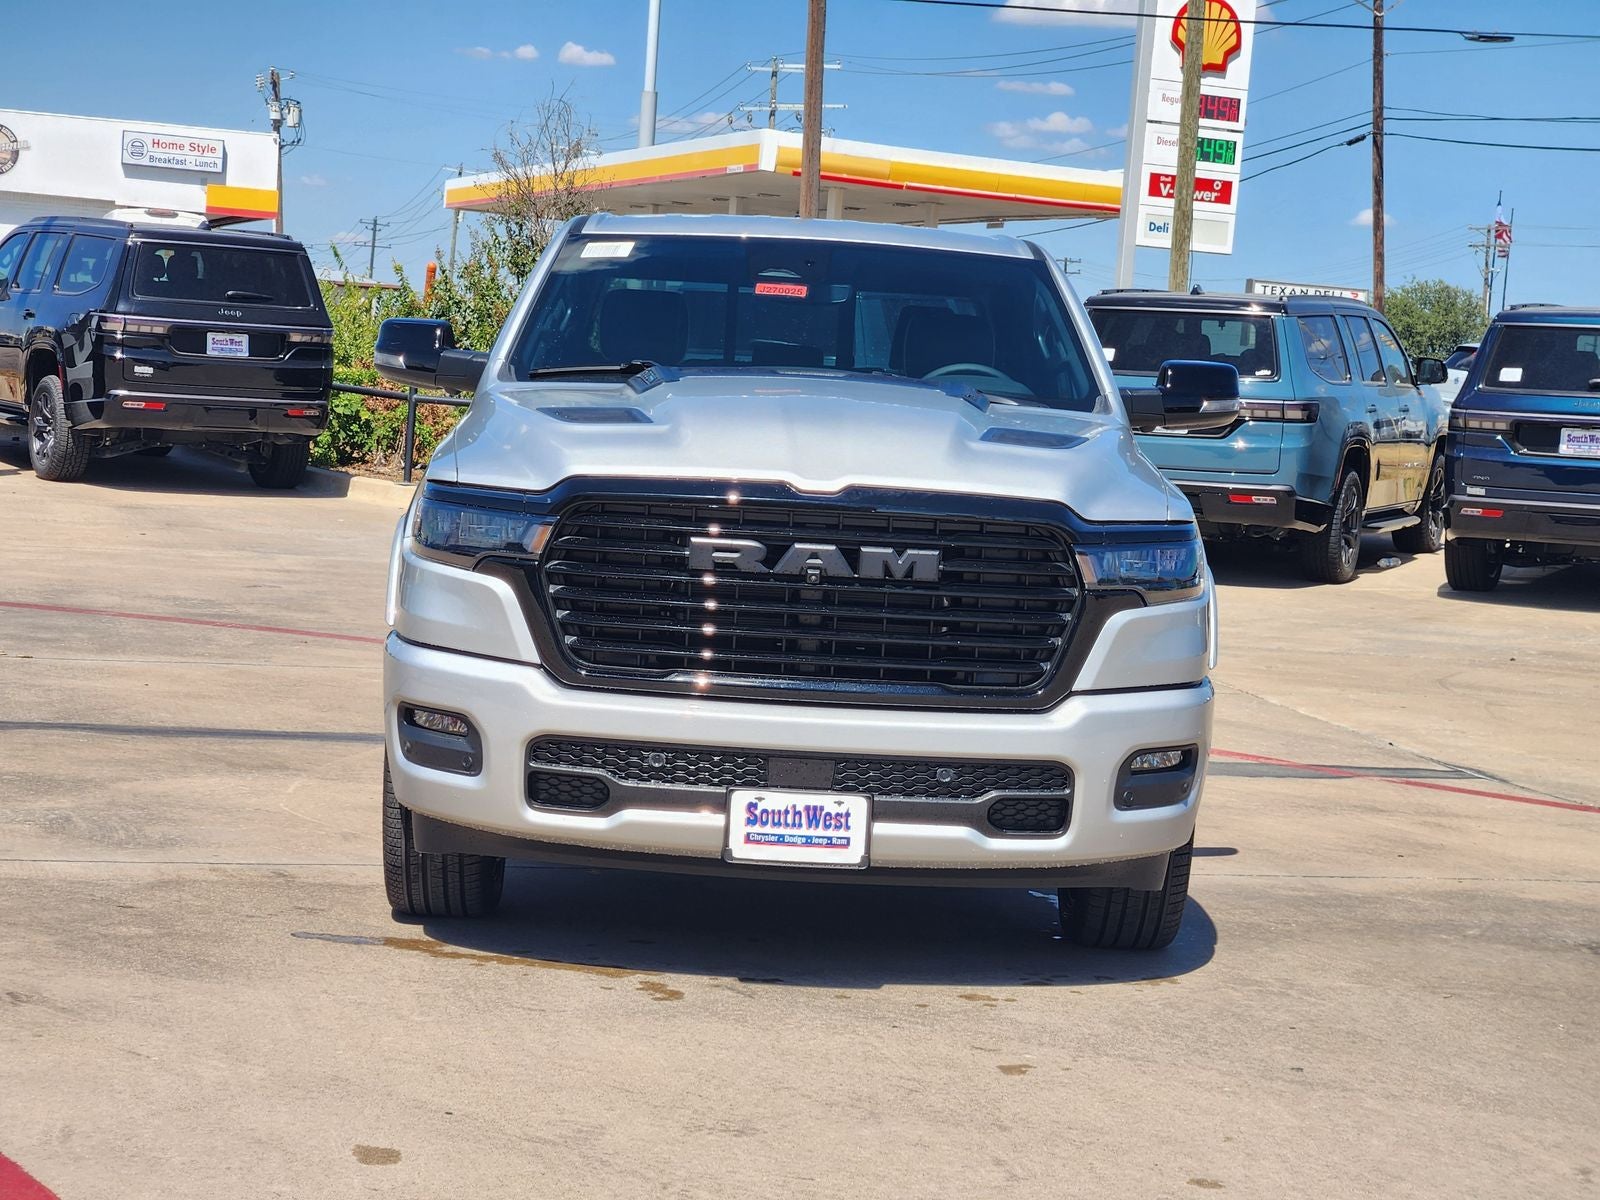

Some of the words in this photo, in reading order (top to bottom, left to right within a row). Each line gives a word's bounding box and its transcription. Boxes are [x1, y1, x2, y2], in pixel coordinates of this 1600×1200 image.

[1161, 93, 1181, 105] Regu
[152, 138, 185, 151] Home
[189, 142, 217, 155] Style
[1156, 135, 1179, 147] Diesel
[149, 154, 187, 166] Breakfast
[194, 159, 218, 169] Lunch
[1148, 221, 1170, 233] Deli
[759, 285, 803, 296] J270025
[1261, 284, 1309, 295] TEXAN
[218, 308, 242, 317] Jeep
[211, 337, 244, 347] SouthWest
[688, 536, 941, 582] RAM
[745, 801, 852, 832] SouthWest
[749, 833, 778, 843] Chrysler
[784, 836, 806, 845] Dodge
[811, 837, 828, 846] Jeep
